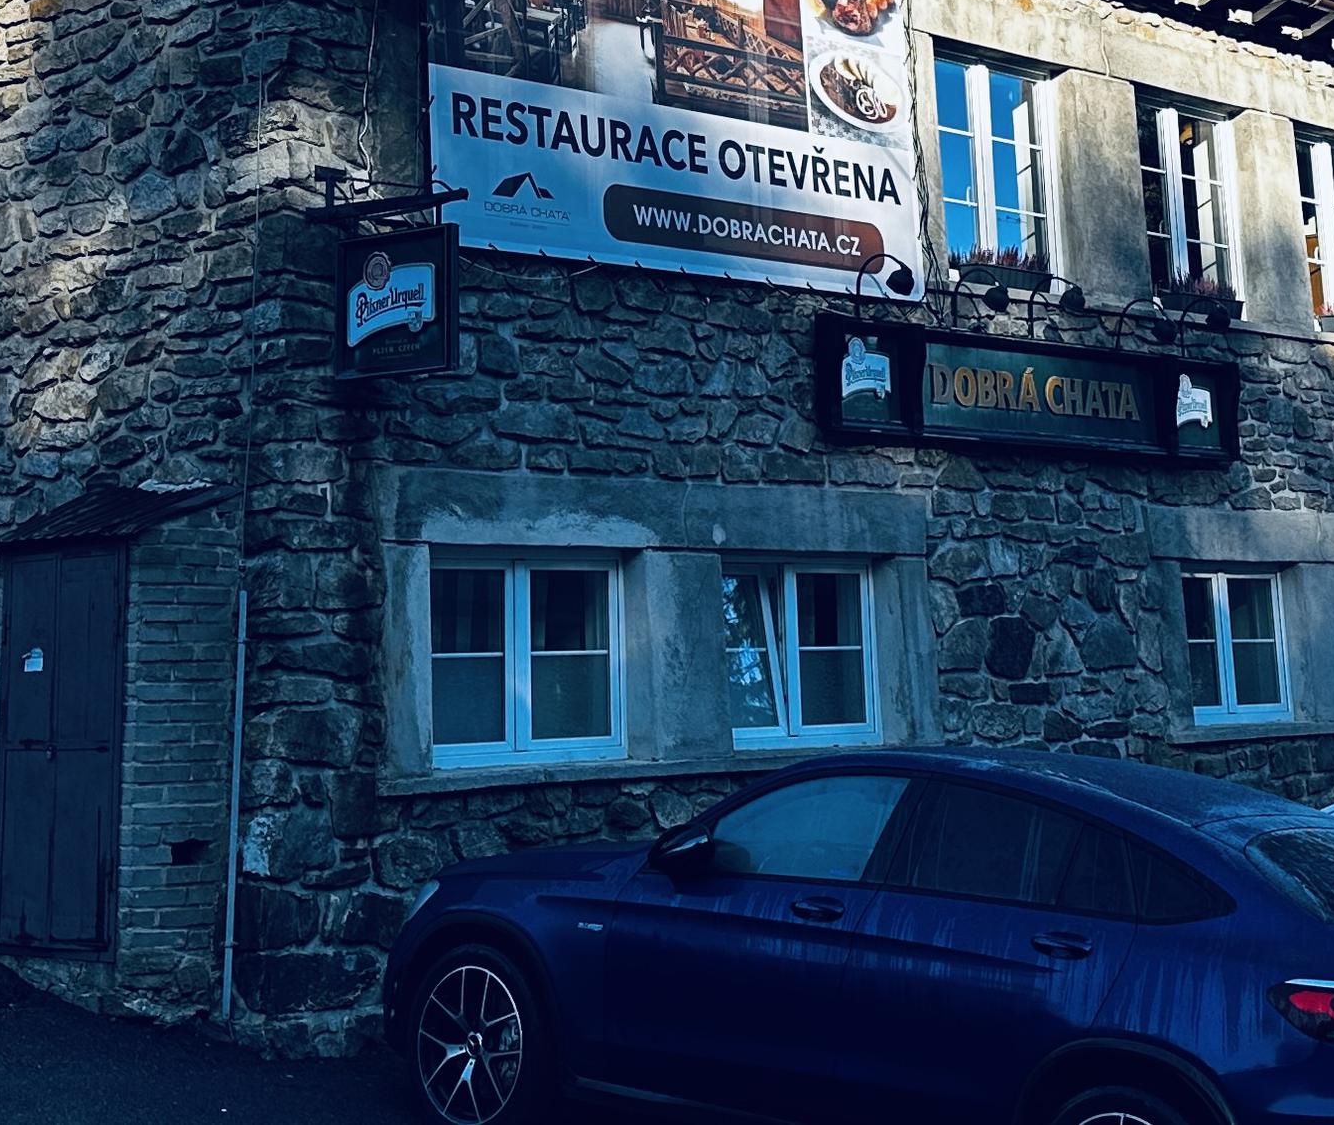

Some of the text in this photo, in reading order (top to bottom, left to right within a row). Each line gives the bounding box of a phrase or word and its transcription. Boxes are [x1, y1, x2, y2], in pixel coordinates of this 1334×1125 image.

[452, 92, 902, 206] RESTAURACE OTEVŘENA
[531, 207, 571, 221] CHATA
[633, 204, 861, 256] WWW.DOBRACHATA.CZ
[355, 283, 427, 327] Pilsner Urquell
[929, 366, 1141, 421] DOBRÁ CHATA
